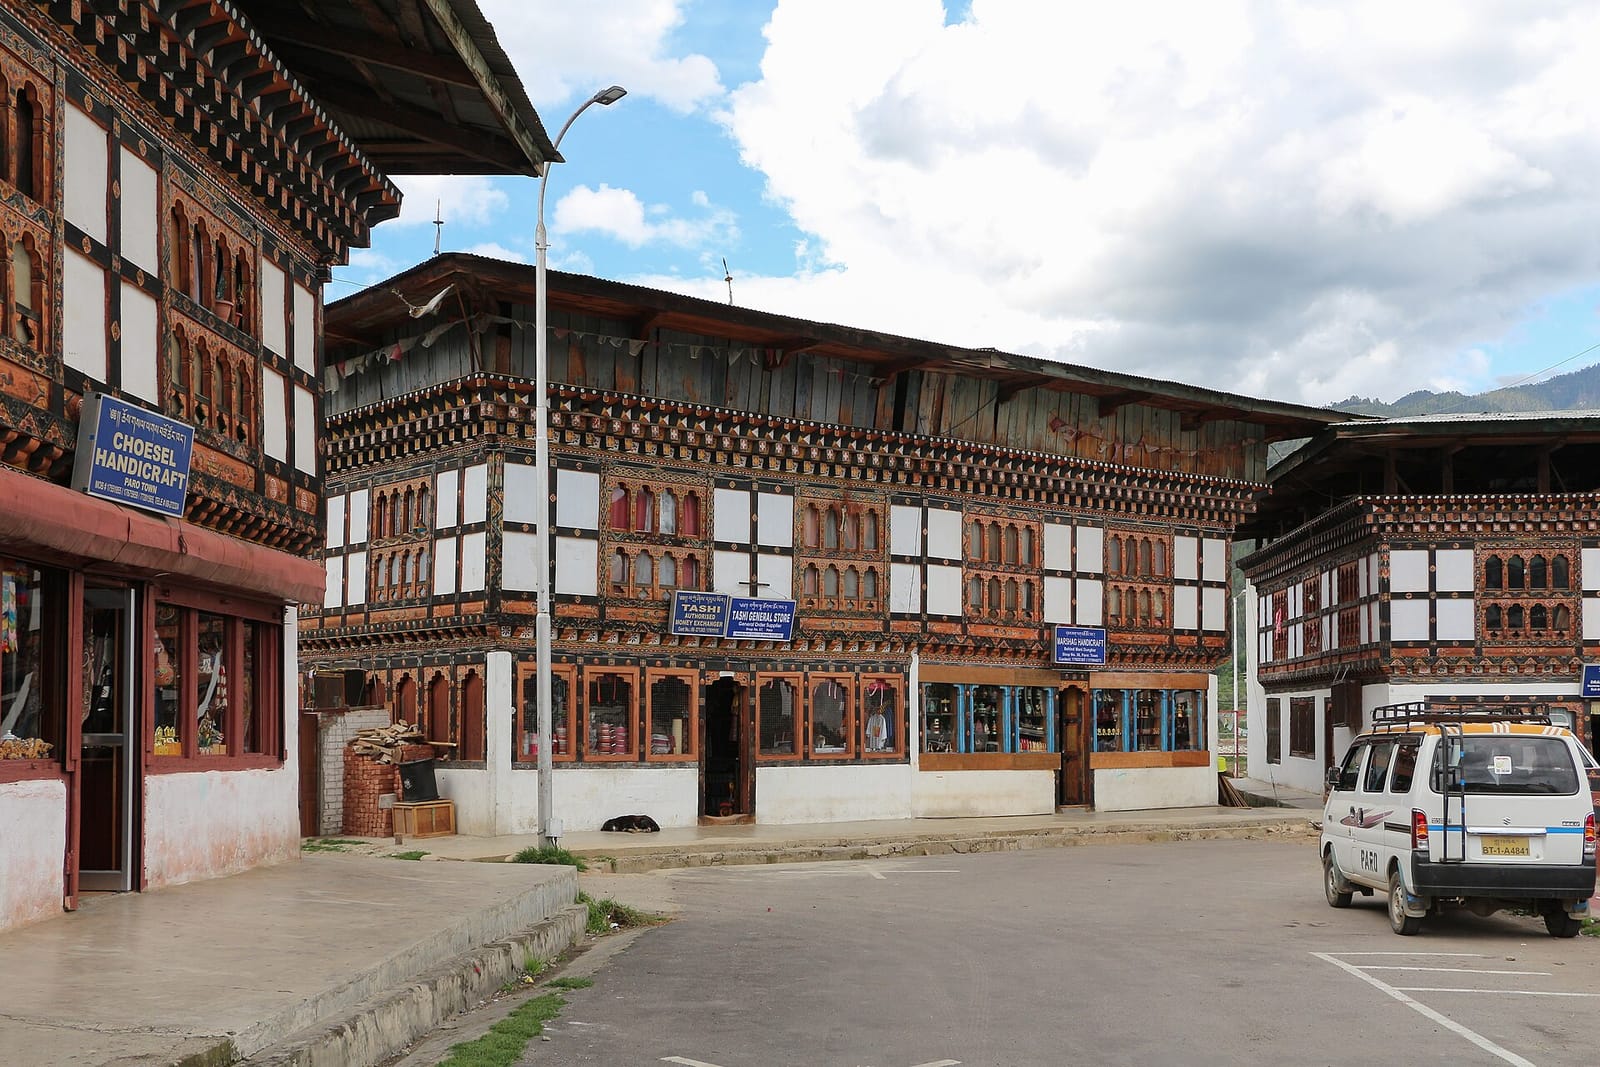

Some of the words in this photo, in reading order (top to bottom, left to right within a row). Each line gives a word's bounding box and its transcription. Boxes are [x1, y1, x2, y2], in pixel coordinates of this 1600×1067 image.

[113, 432, 176, 467] CHOESEL
[95, 448, 186, 490] HANDICRAFT
[124, 477, 140, 489] PARO
[141, 481, 158, 494] TOWN
[681, 604, 721, 613] TASHI
[732, 610, 749, 621] TASHI
[749, 611, 773, 622] GENERAL
[773, 613, 791, 623] STORE
[675, 619, 693, 627] MONEY
[693, 620, 724, 628] EXCHANGER
[1078, 638, 1104, 647] HANDICRAFT
[1482, 846, 1529, 855] BT-1-A4841
[1360, 849, 1378, 873] PARO
